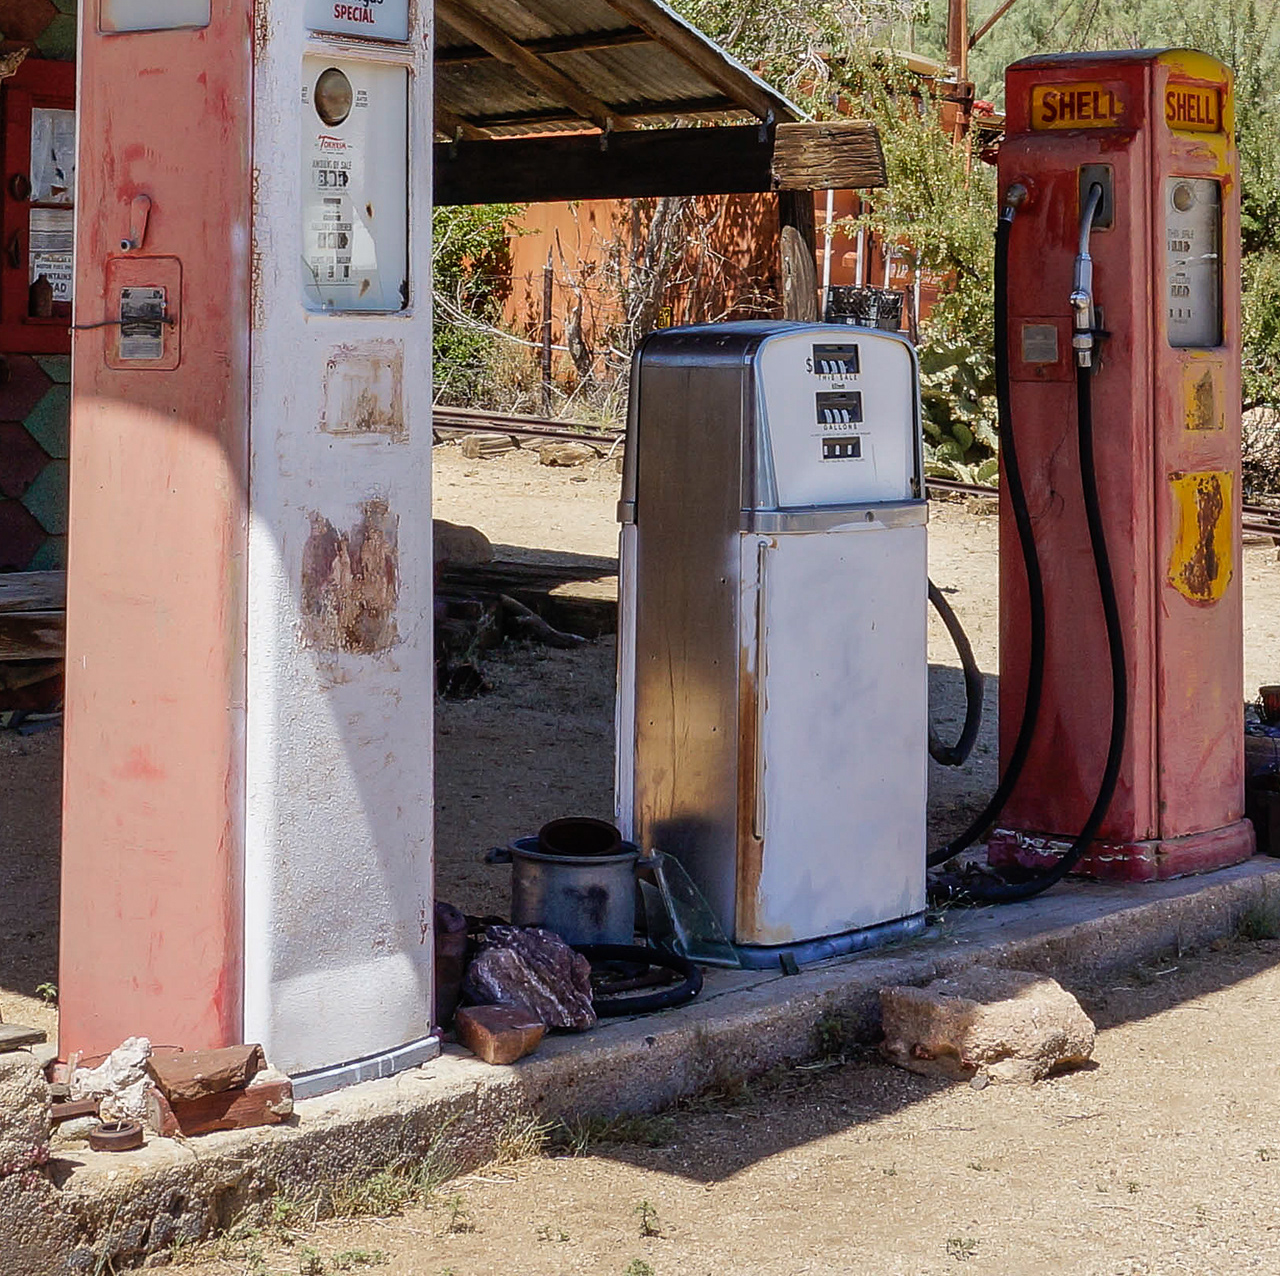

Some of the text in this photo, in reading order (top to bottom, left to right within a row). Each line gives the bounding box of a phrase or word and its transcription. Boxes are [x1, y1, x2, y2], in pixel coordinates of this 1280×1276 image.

[334, 4, 375, 24] SPECIAL
[1041, 90, 1118, 123] SHELL
[1166, 90, 1215, 124] SHELL
[805, 357, 813, 374] $
